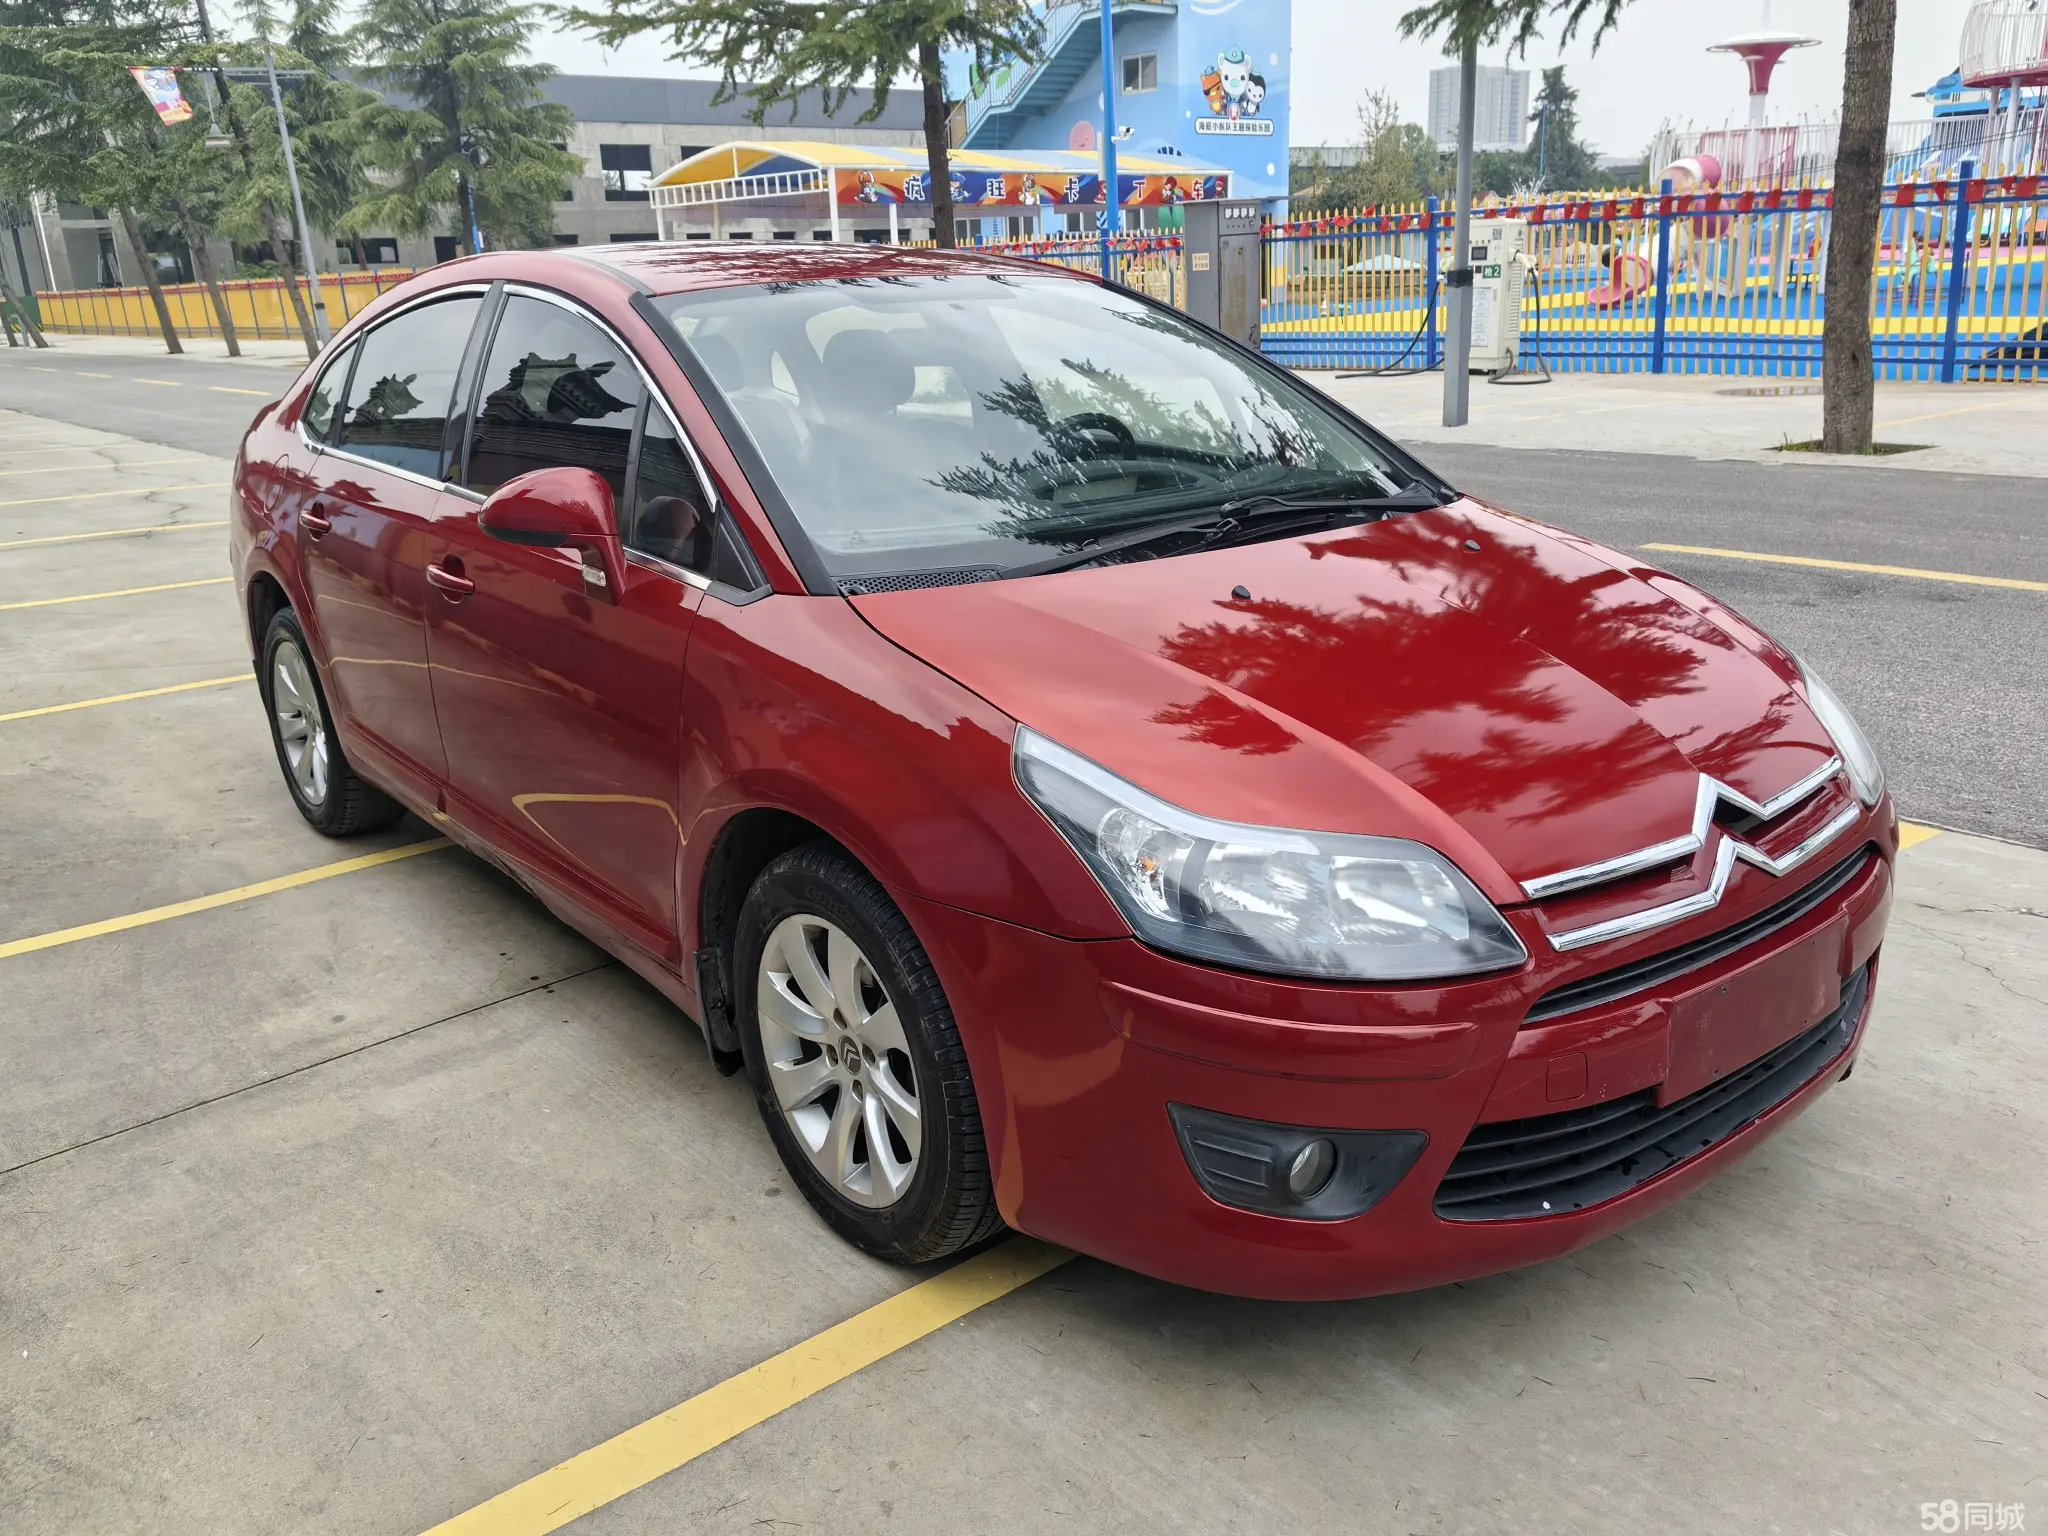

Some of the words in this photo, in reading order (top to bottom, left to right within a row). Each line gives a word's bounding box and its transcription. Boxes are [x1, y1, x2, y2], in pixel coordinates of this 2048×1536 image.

[903, 174, 1204, 203] 疯狂卡丁车
